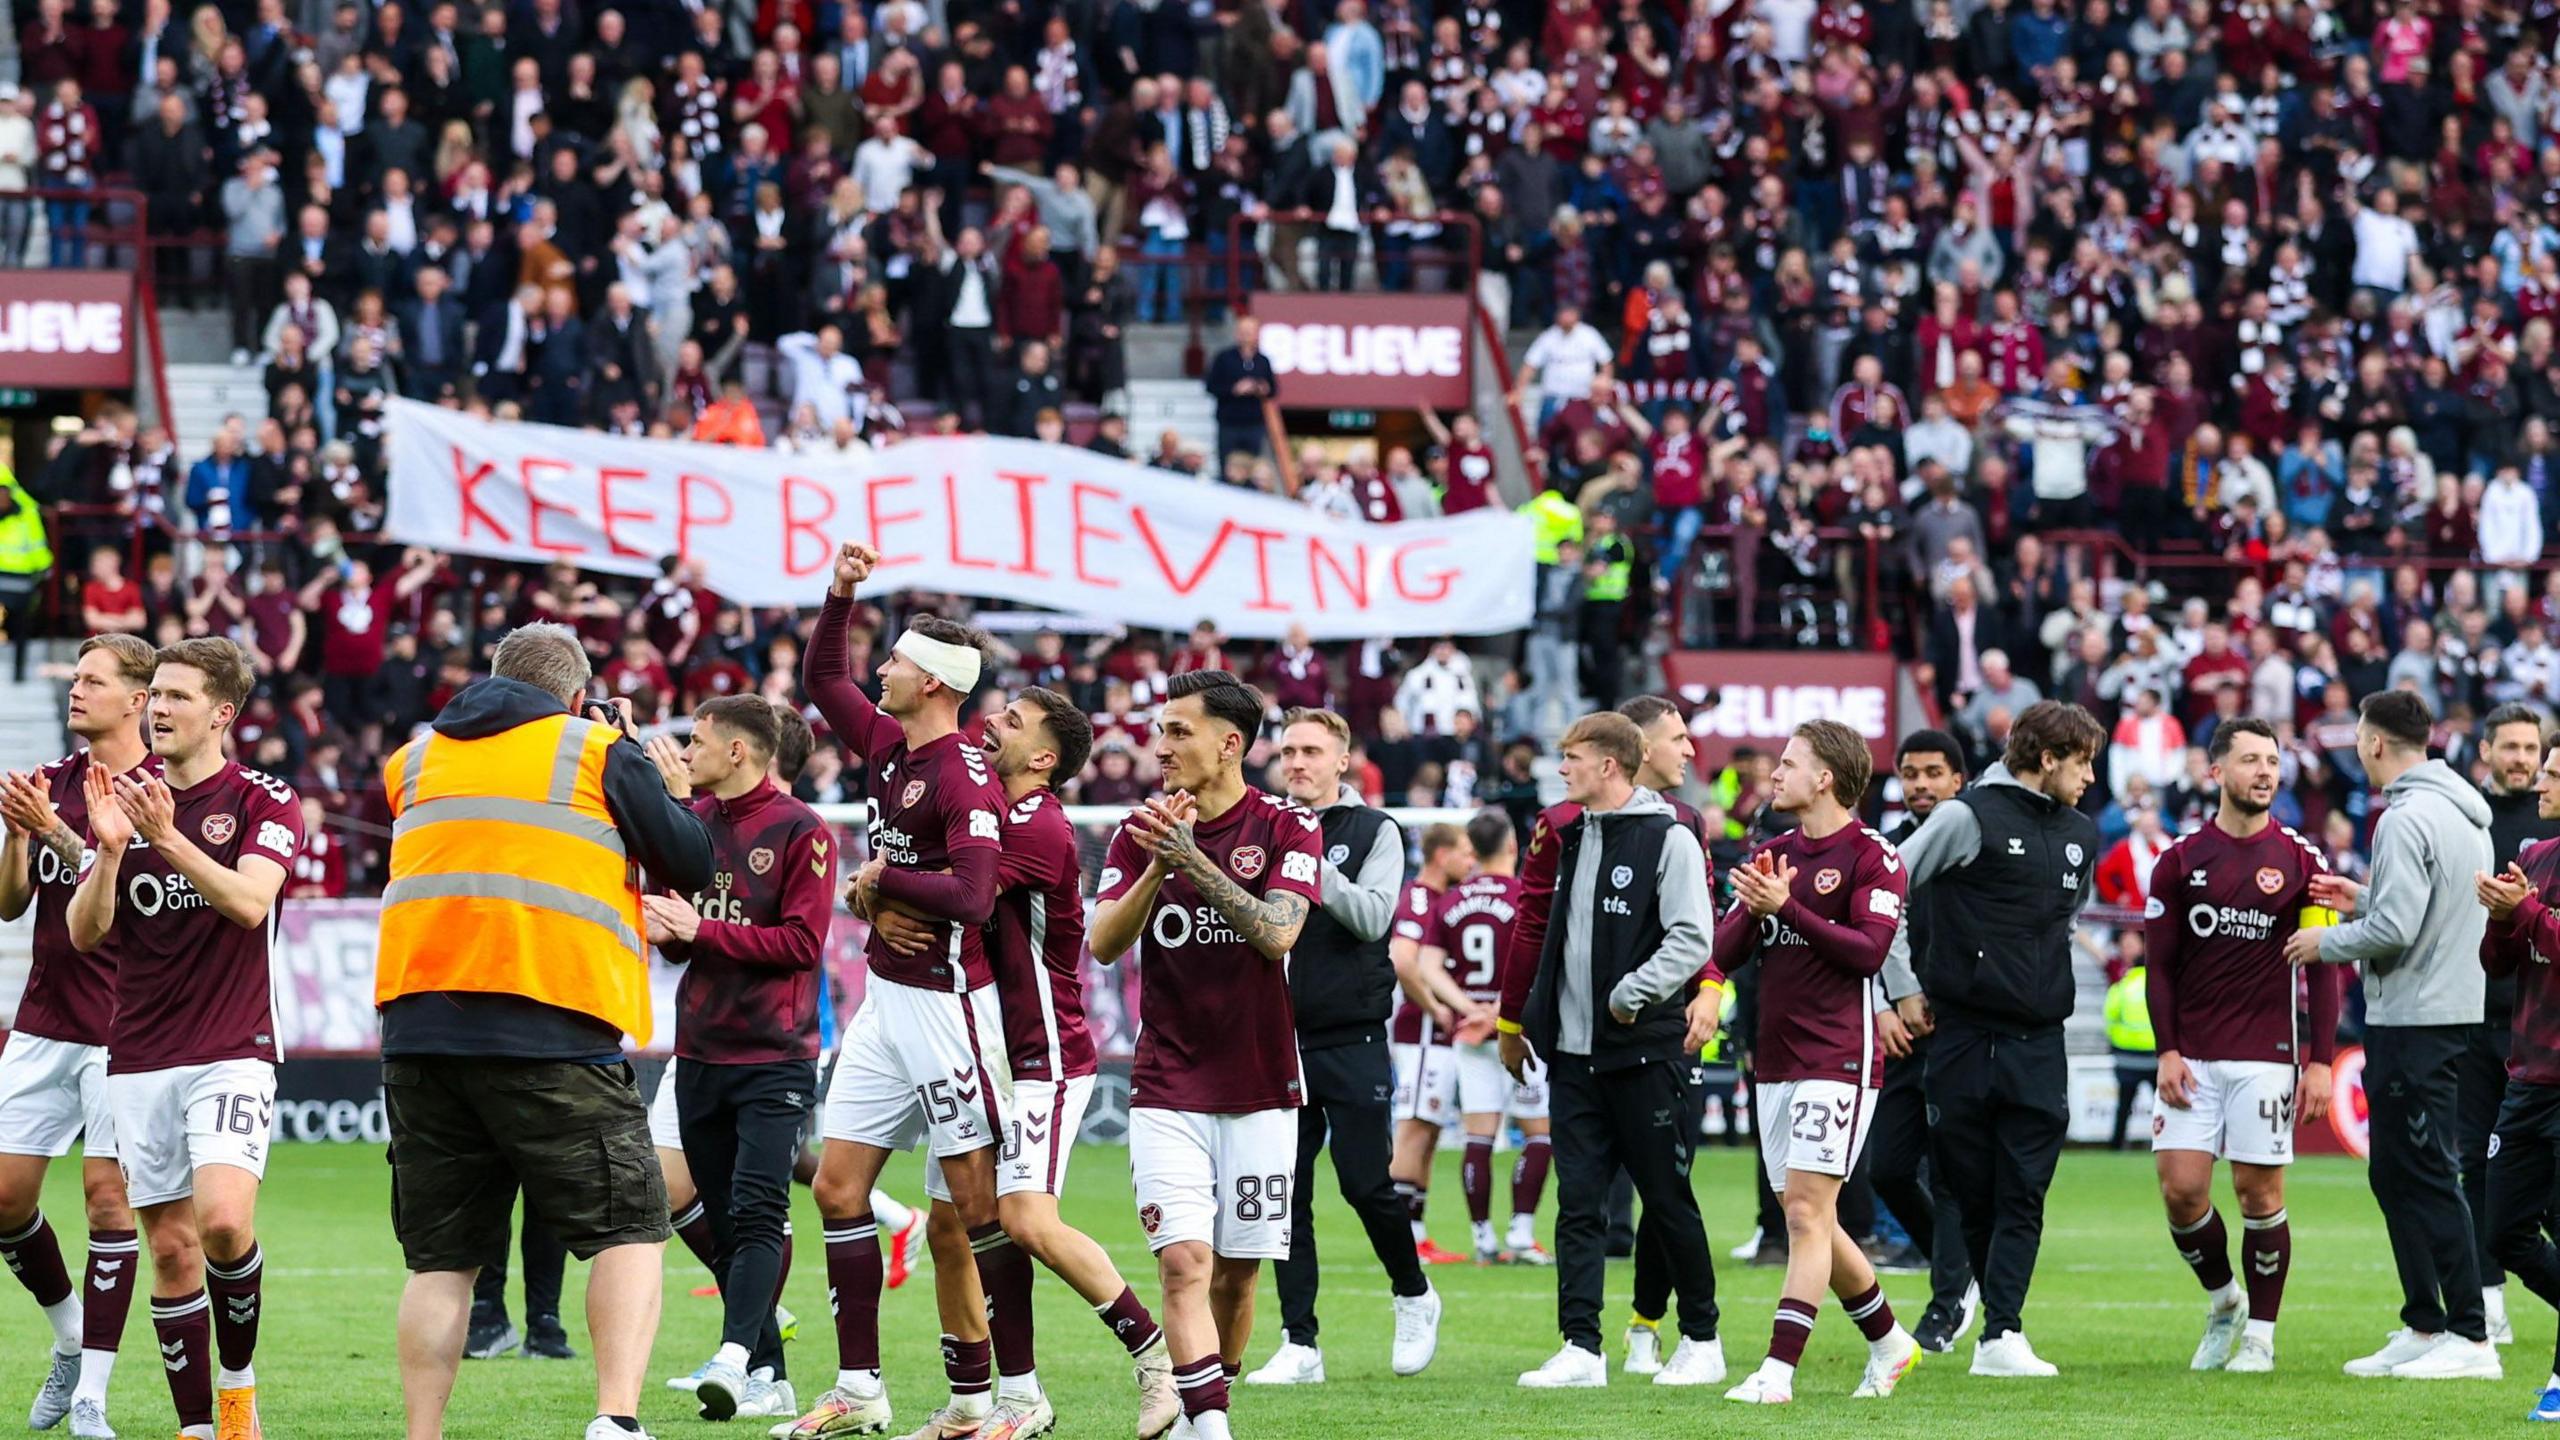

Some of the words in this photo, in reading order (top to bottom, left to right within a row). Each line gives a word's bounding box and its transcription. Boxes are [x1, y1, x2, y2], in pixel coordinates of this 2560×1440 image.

[1258, 323, 1462, 377] BELIEVE
[450, 445, 733, 562] KEEP
[780, 470, 1463, 612] BELIEVING
[714, 871, 733, 890] 99
[2219, 907, 2277, 927] Stellar
[1462, 924, 1495, 985] 9
[215, 1094, 256, 1135] 16
[917, 1079, 958, 1125] 15
[1792, 1101, 1831, 1142] 23
[2259, 1100, 2277, 1133] 4
[1236, 1174, 1287, 1221] 89
